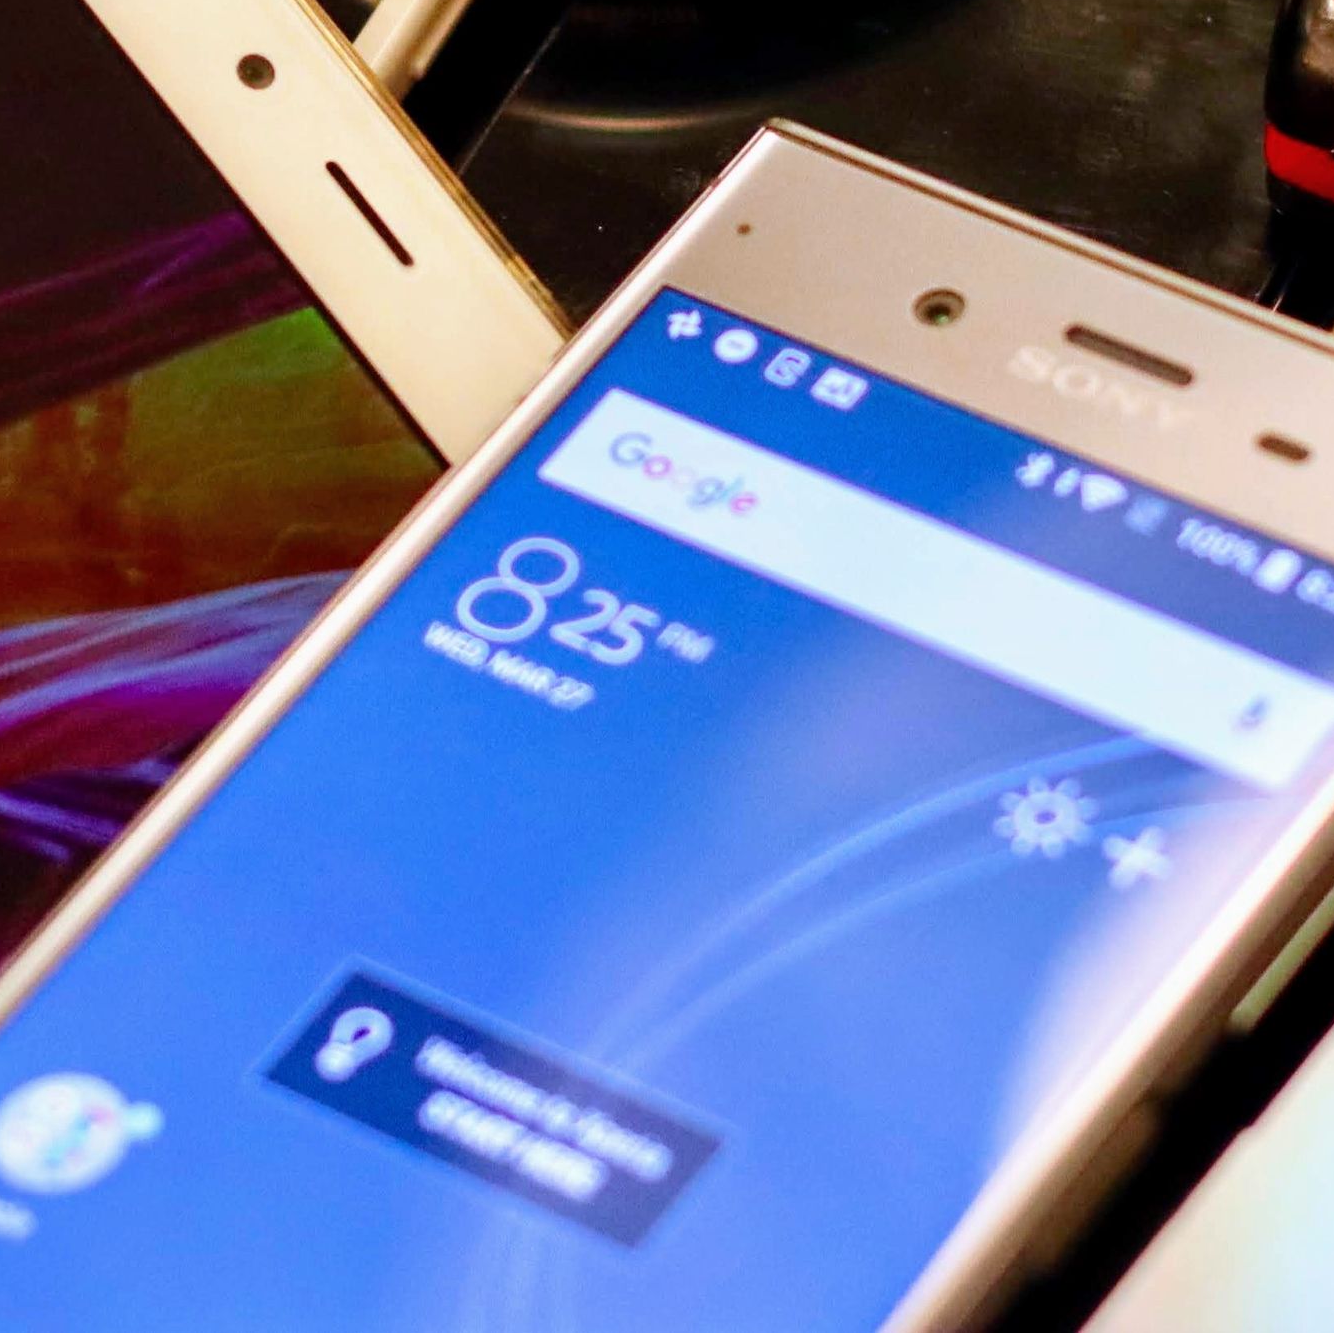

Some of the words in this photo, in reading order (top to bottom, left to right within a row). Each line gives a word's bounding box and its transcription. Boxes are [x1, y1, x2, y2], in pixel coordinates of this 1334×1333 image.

[1005, 344, 1193, 430] SONY
[609, 430, 760, 517] Google
[456, 536, 581, 643] 8
[549, 588, 662, 665] 25
[657, 621, 715, 665] PM
